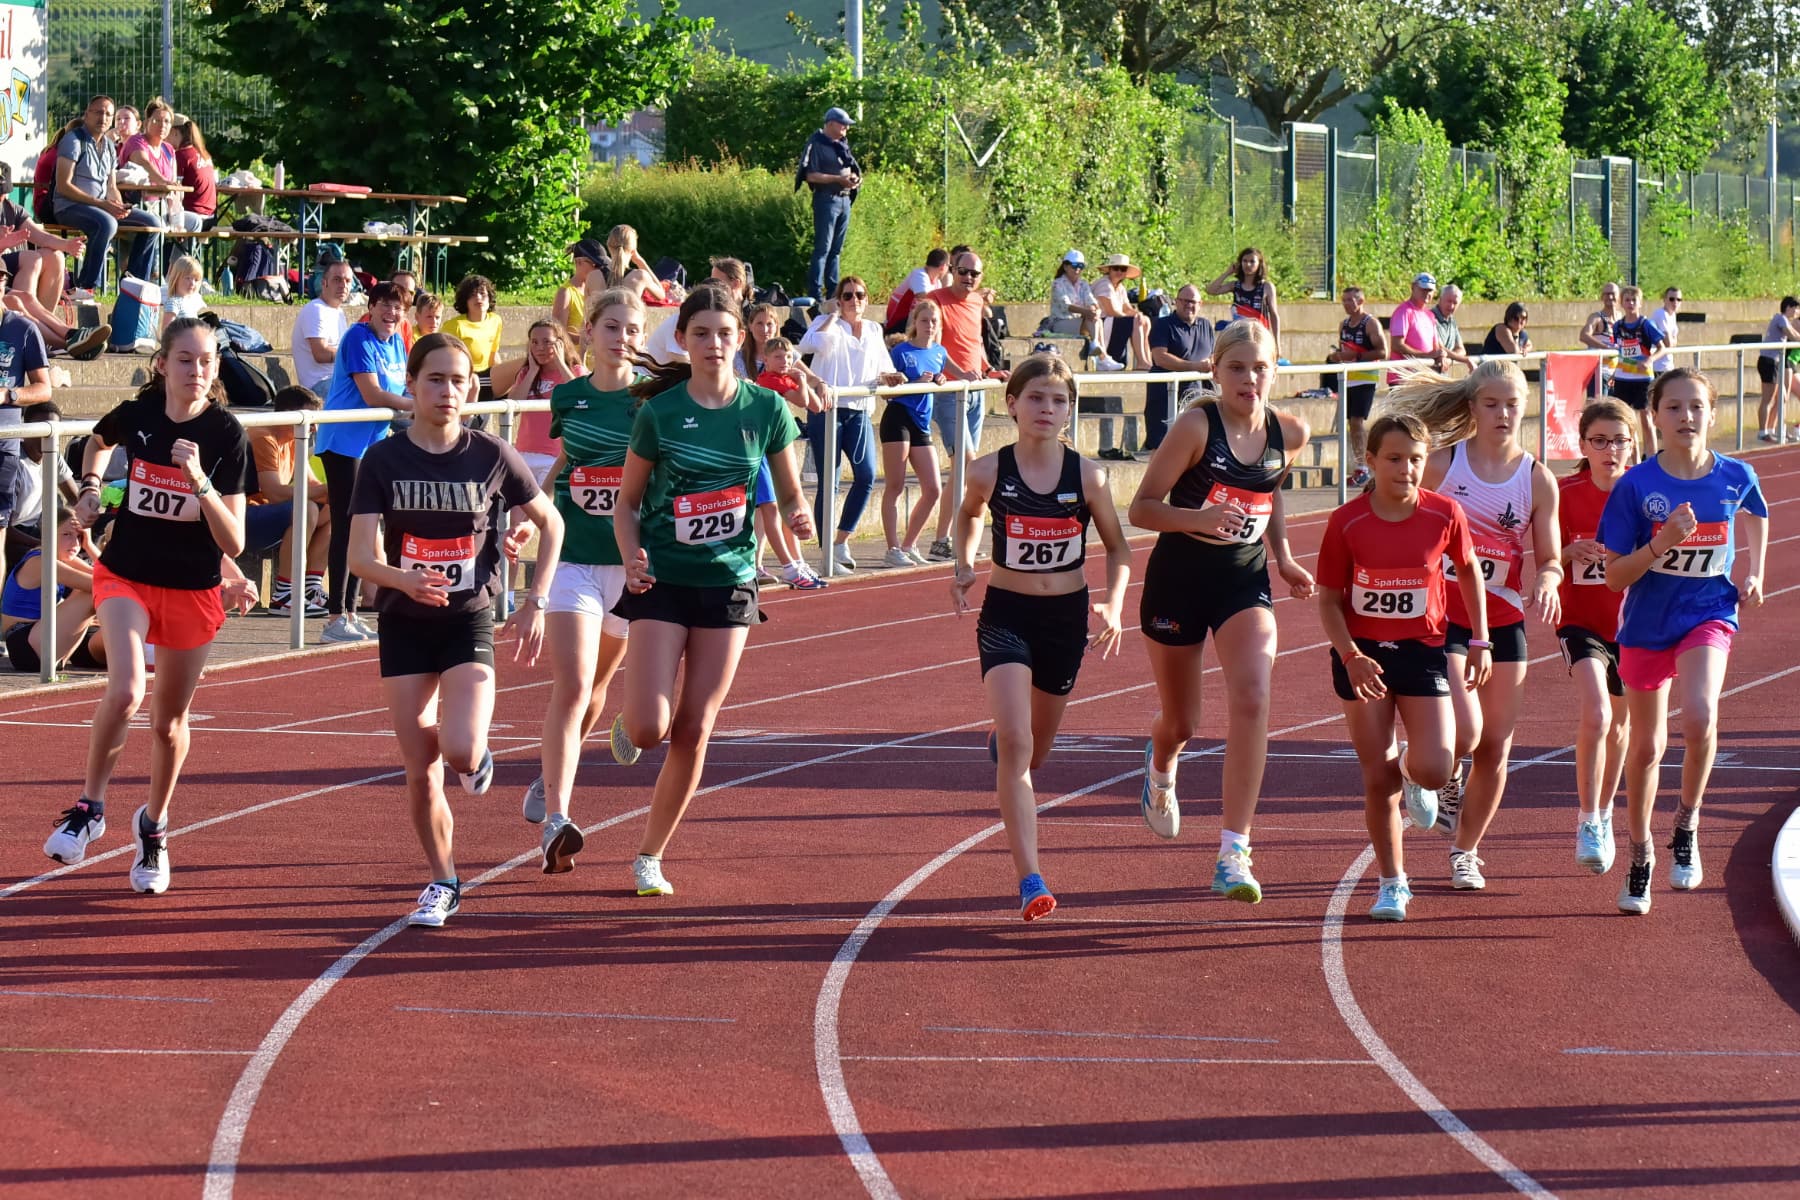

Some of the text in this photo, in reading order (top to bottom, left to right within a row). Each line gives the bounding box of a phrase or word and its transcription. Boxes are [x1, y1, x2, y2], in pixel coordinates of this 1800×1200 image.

[149, 473, 191, 490] Sparkass
[137, 487, 187, 517] 207
[392, 480, 487, 513] NIRVANA
[696, 495, 741, 513] Sparkasse
[688, 512, 735, 541] 229
[1028, 526, 1078, 538] Sparkasse
[1685, 532, 1724, 544] arkasse
[421, 548, 471, 560] Sparkasse
[1018, 541, 1070, 565] 267
[1472, 543, 1506, 557] rkasse
[1662, 548, 1714, 573] 277
[1373, 577, 1424, 589] Sparkasse
[1362, 591, 1414, 614] 298
